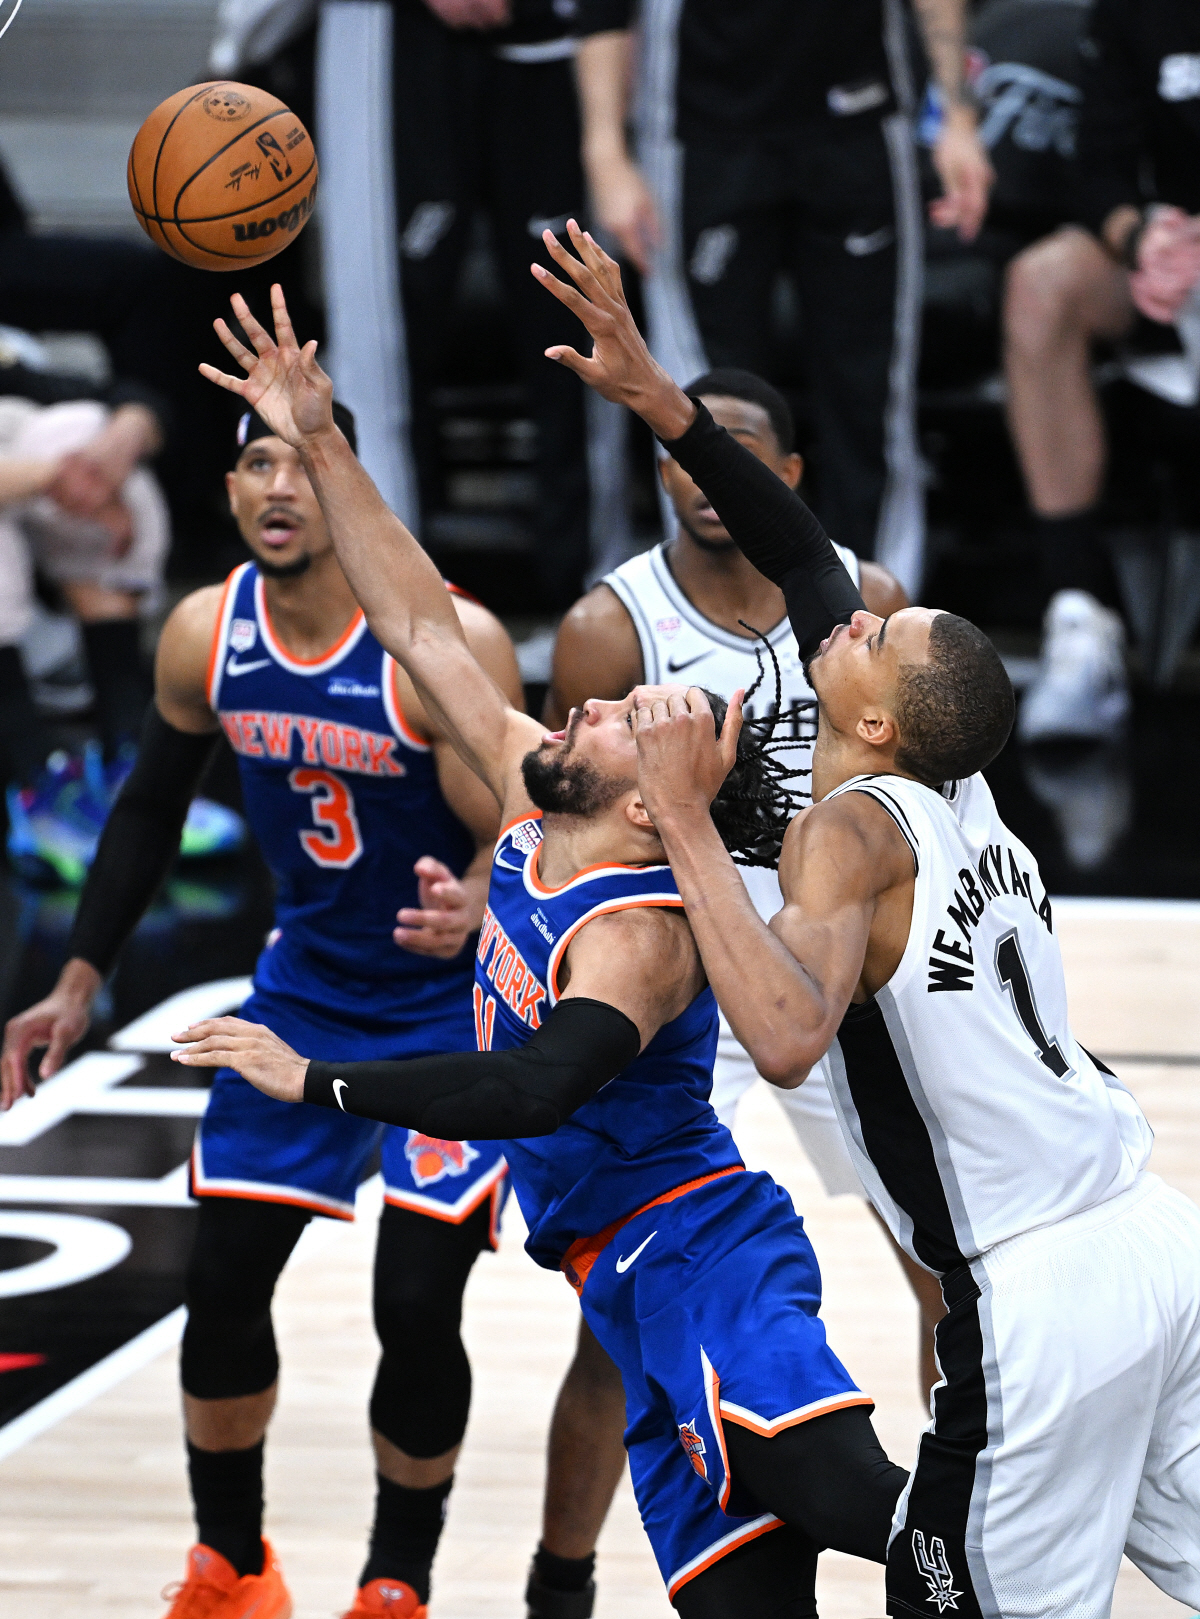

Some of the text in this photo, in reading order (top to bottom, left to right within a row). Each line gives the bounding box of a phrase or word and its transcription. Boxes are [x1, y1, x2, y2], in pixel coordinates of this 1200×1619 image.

[218, 710, 407, 777] NEW YORK
[287, 766, 364, 869] 3
[524, 822, 542, 845] USA
[486, 926, 548, 1030] YORK
[993, 926, 1078, 1083] 1
